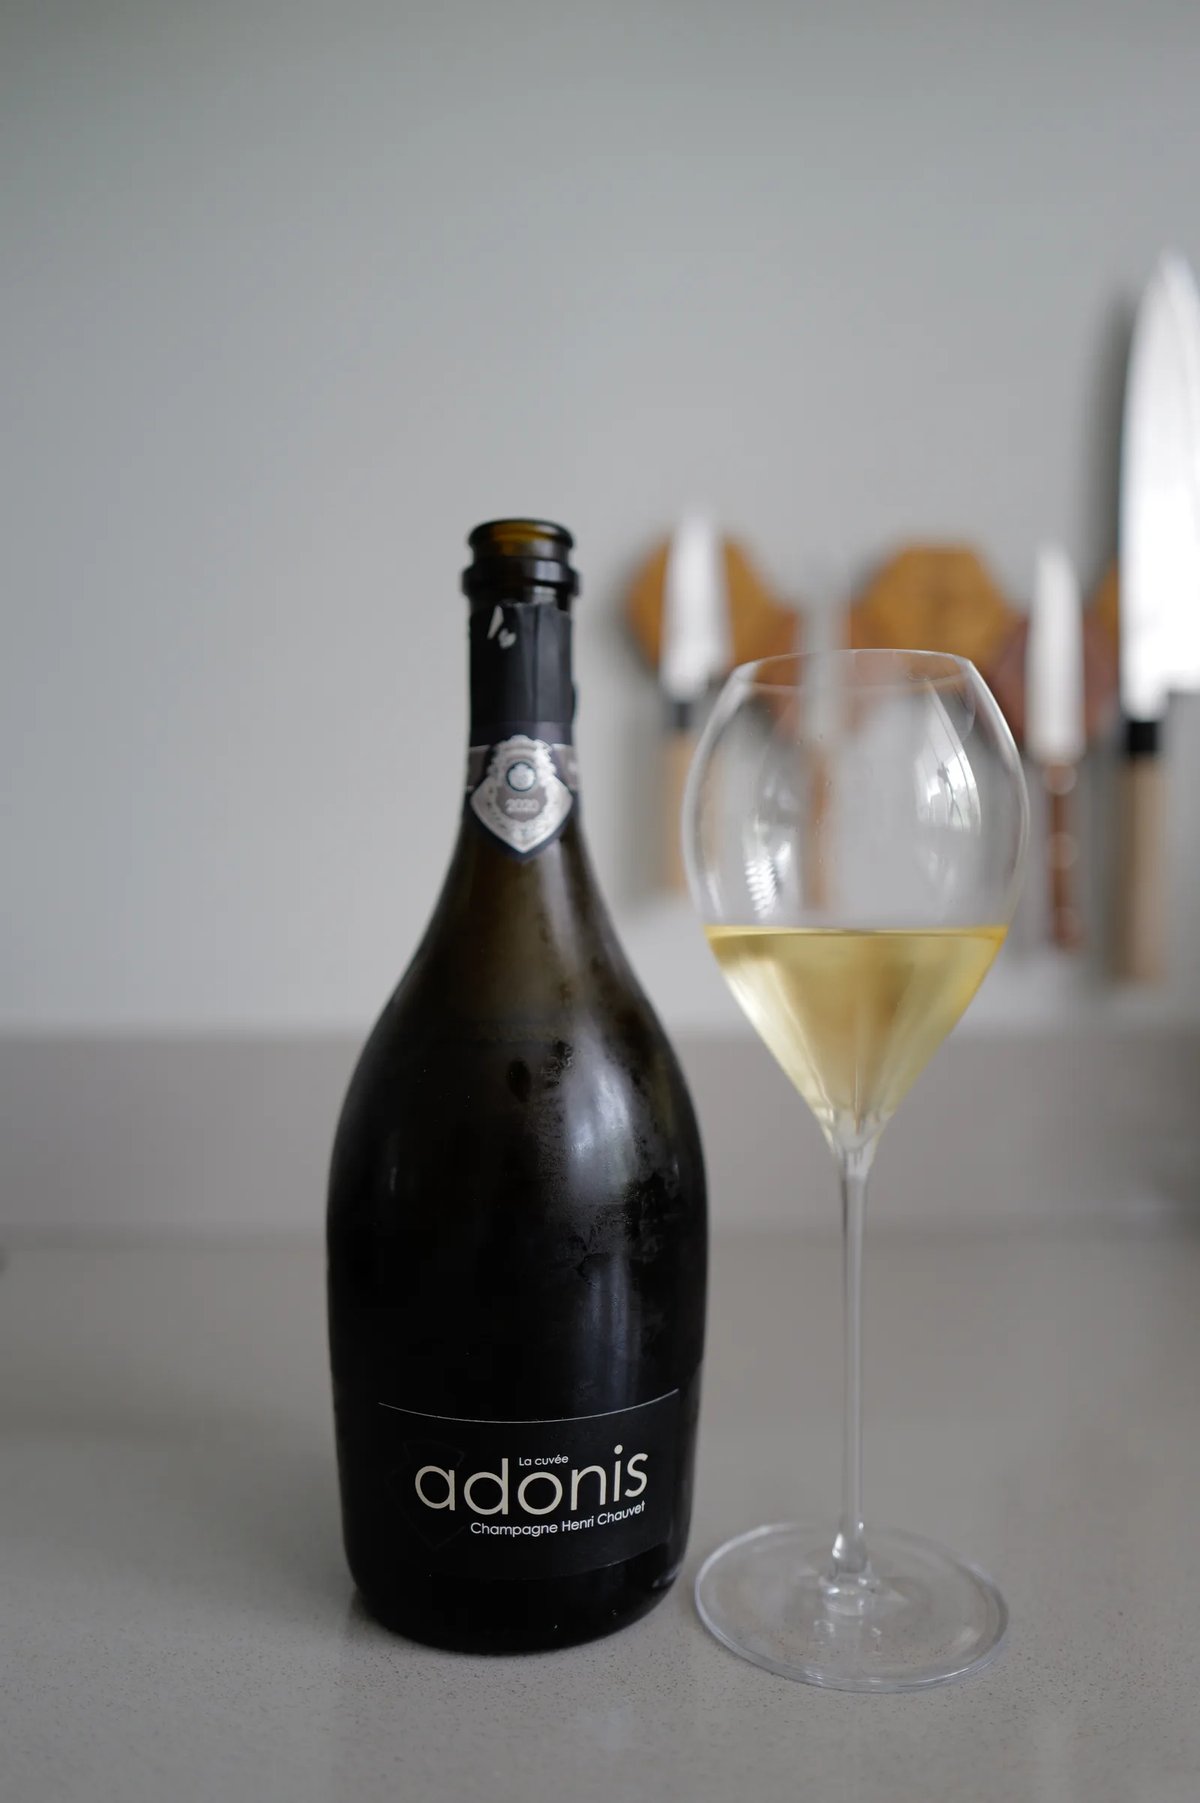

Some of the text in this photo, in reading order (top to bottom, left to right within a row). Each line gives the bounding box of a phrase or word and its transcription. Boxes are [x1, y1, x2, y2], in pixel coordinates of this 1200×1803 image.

[415, 1444, 649, 1516] adonis
[519, 1454, 569, 1467] La cuvée
[471, 1500, 646, 1539] Champagne Henri Chauvet
